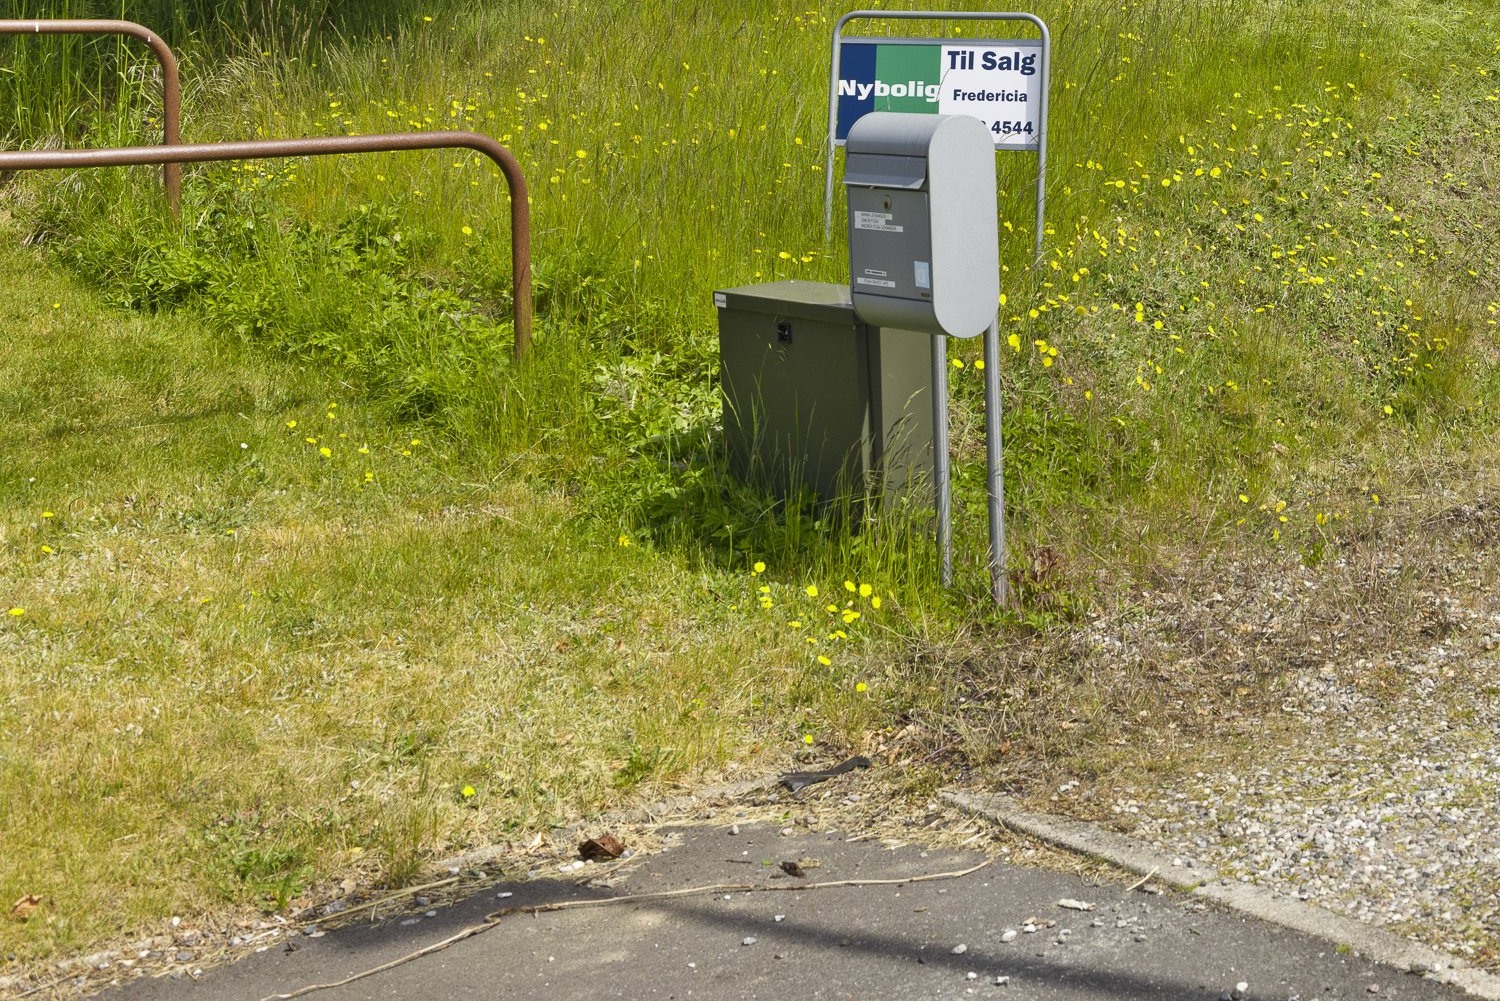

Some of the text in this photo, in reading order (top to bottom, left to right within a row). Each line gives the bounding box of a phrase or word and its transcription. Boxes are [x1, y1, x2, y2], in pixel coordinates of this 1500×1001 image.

[947, 50, 1036, 76] Til Salg
[838, 79, 940, 103] Nybolig
[953, 89, 1028, 102] Fredericia
[991, 120, 1034, 135] 4544
